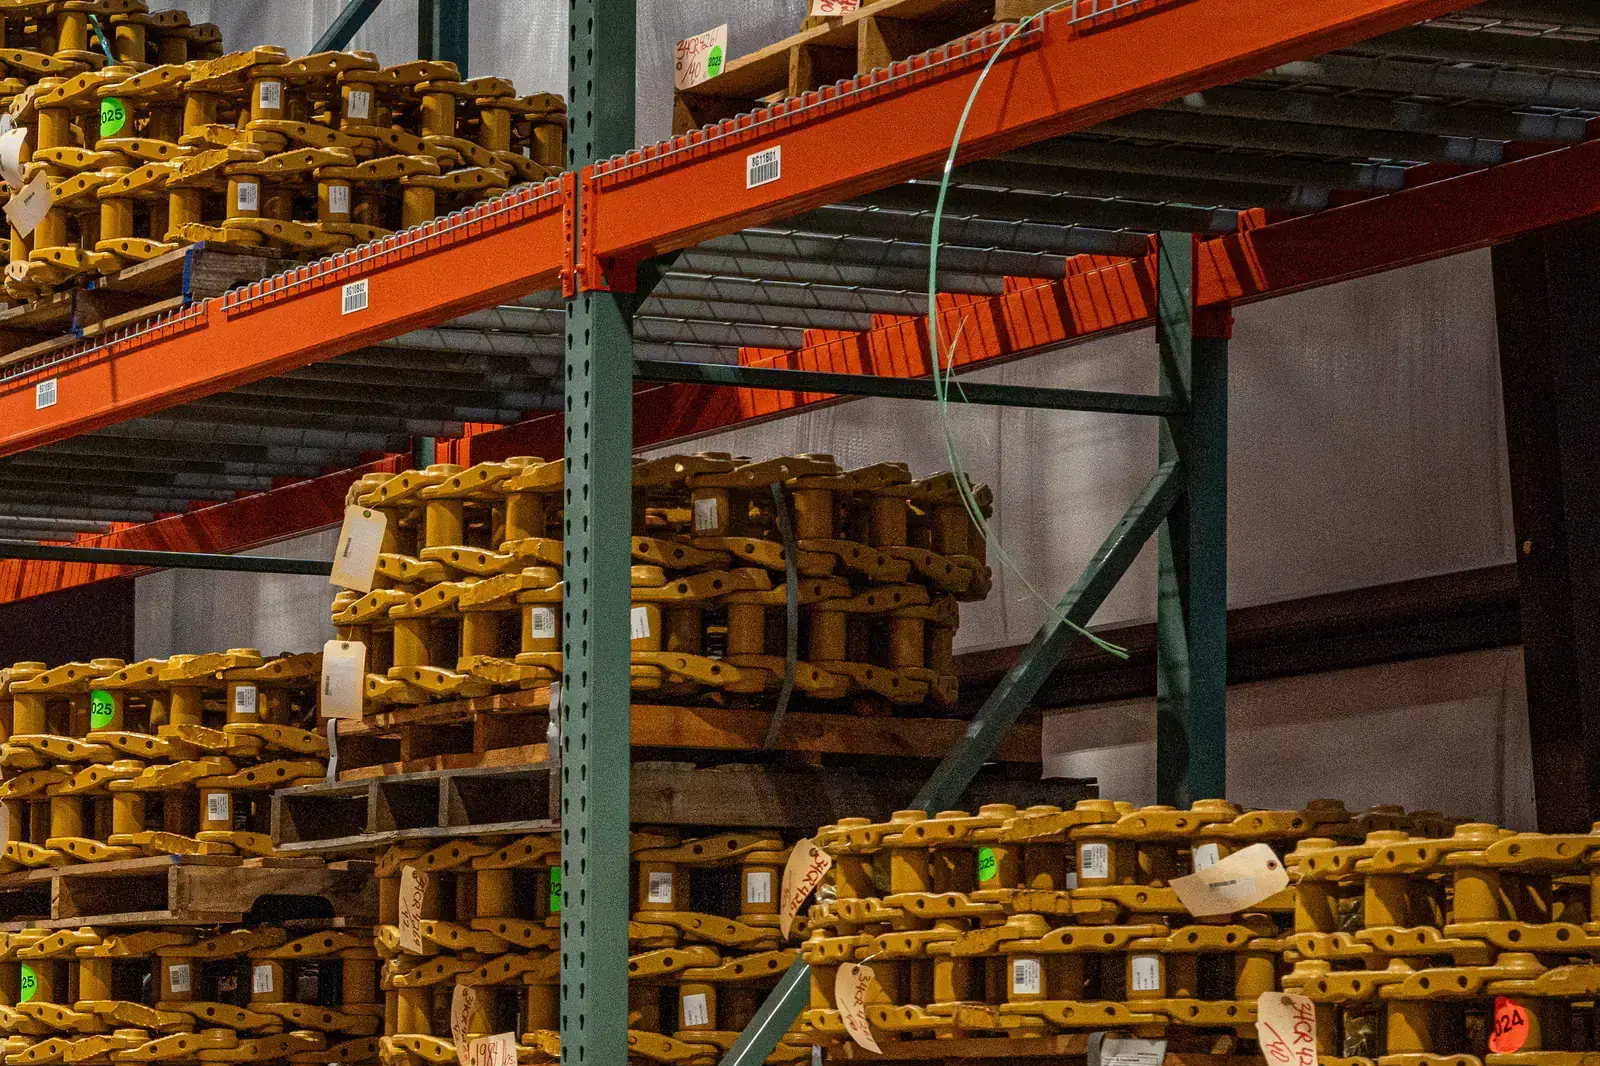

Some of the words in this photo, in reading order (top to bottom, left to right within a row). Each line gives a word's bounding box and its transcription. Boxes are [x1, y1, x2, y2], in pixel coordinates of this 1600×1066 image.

[708, 55, 722, 67] 2025
[101, 109, 123, 123] 025
[752, 151, 776, 166] 8G11B01
[92, 702, 113, 715] 025
[979, 856, 994, 870] 025
[551, 881, 561, 895] 02
[22, 976, 35, 988] 25
[1291, 1003, 1316, 1045] 34CR
[1495, 1010, 1523, 1037] 024
